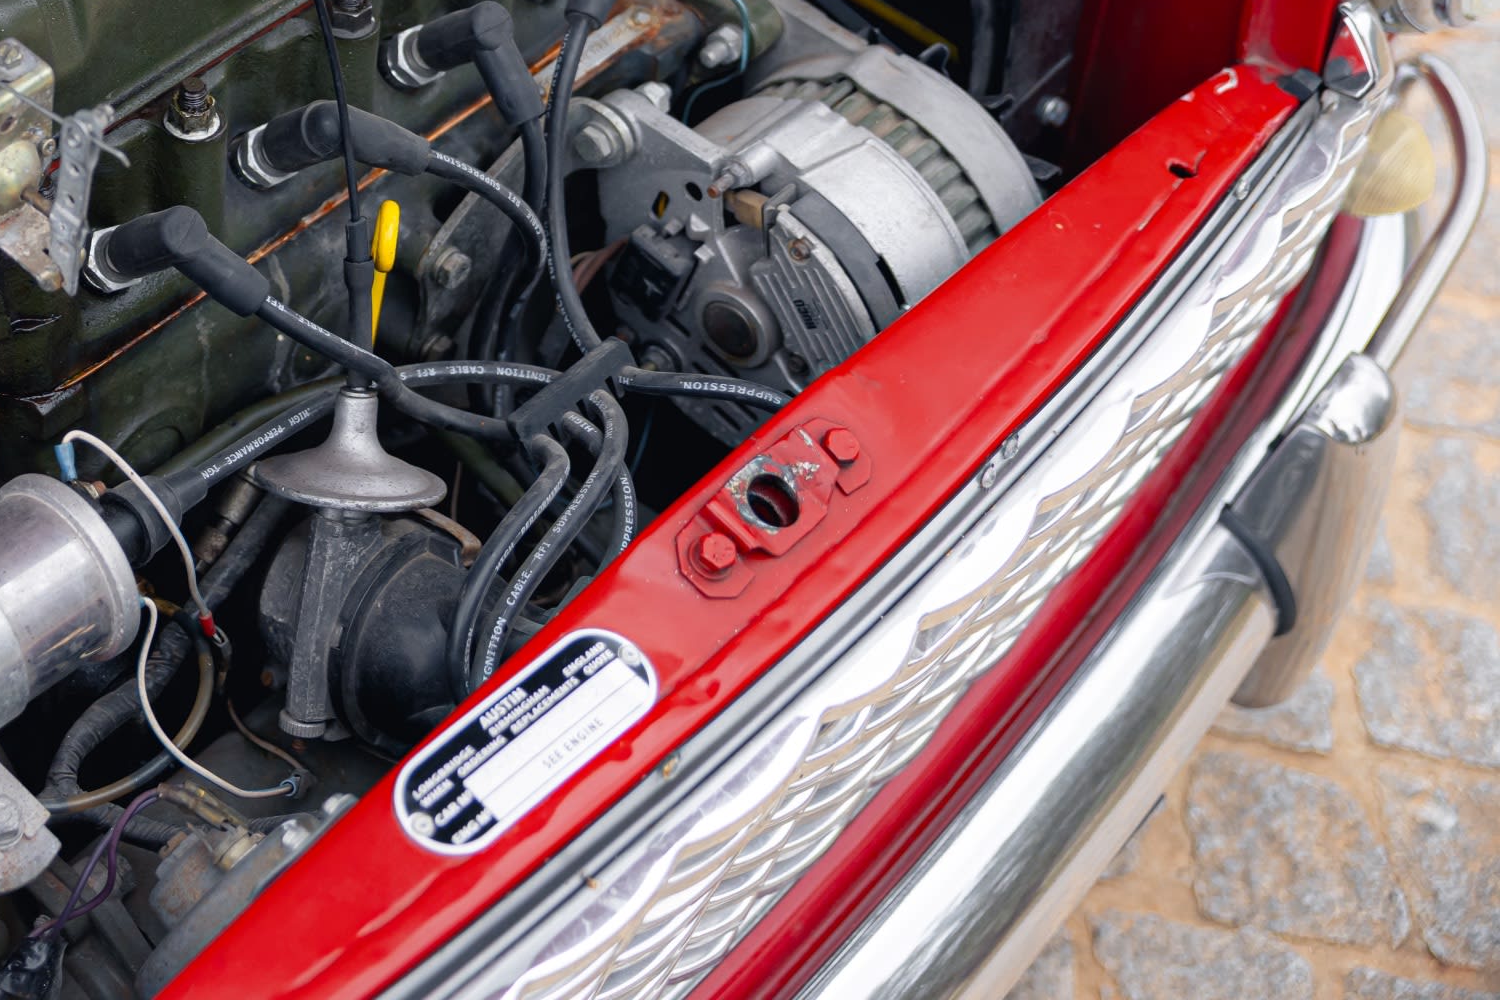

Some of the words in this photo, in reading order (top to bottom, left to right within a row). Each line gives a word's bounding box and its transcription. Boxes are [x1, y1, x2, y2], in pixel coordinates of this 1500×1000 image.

[496, 366, 551, 383] IGNITION
[412, 744, 477, 801] LONGBRIDGE
[487, 684, 551, 739] BIRMINGHAM
[561, 641, 608, 678] ENGLAND
[419, 777, 455, 809] WHEN
[456, 733, 508, 779] ORDERING
[509, 675, 581, 736] REPLACEMENTS
[582, 647, 616, 677] QUOTE
[479, 686, 528, 731] AUSTIN
[541, 749, 564, 769] SEE
[565, 717, 605, 751] ENGINE
[434, 798, 460, 828] CAR
[451, 819, 481, 845] ENG
